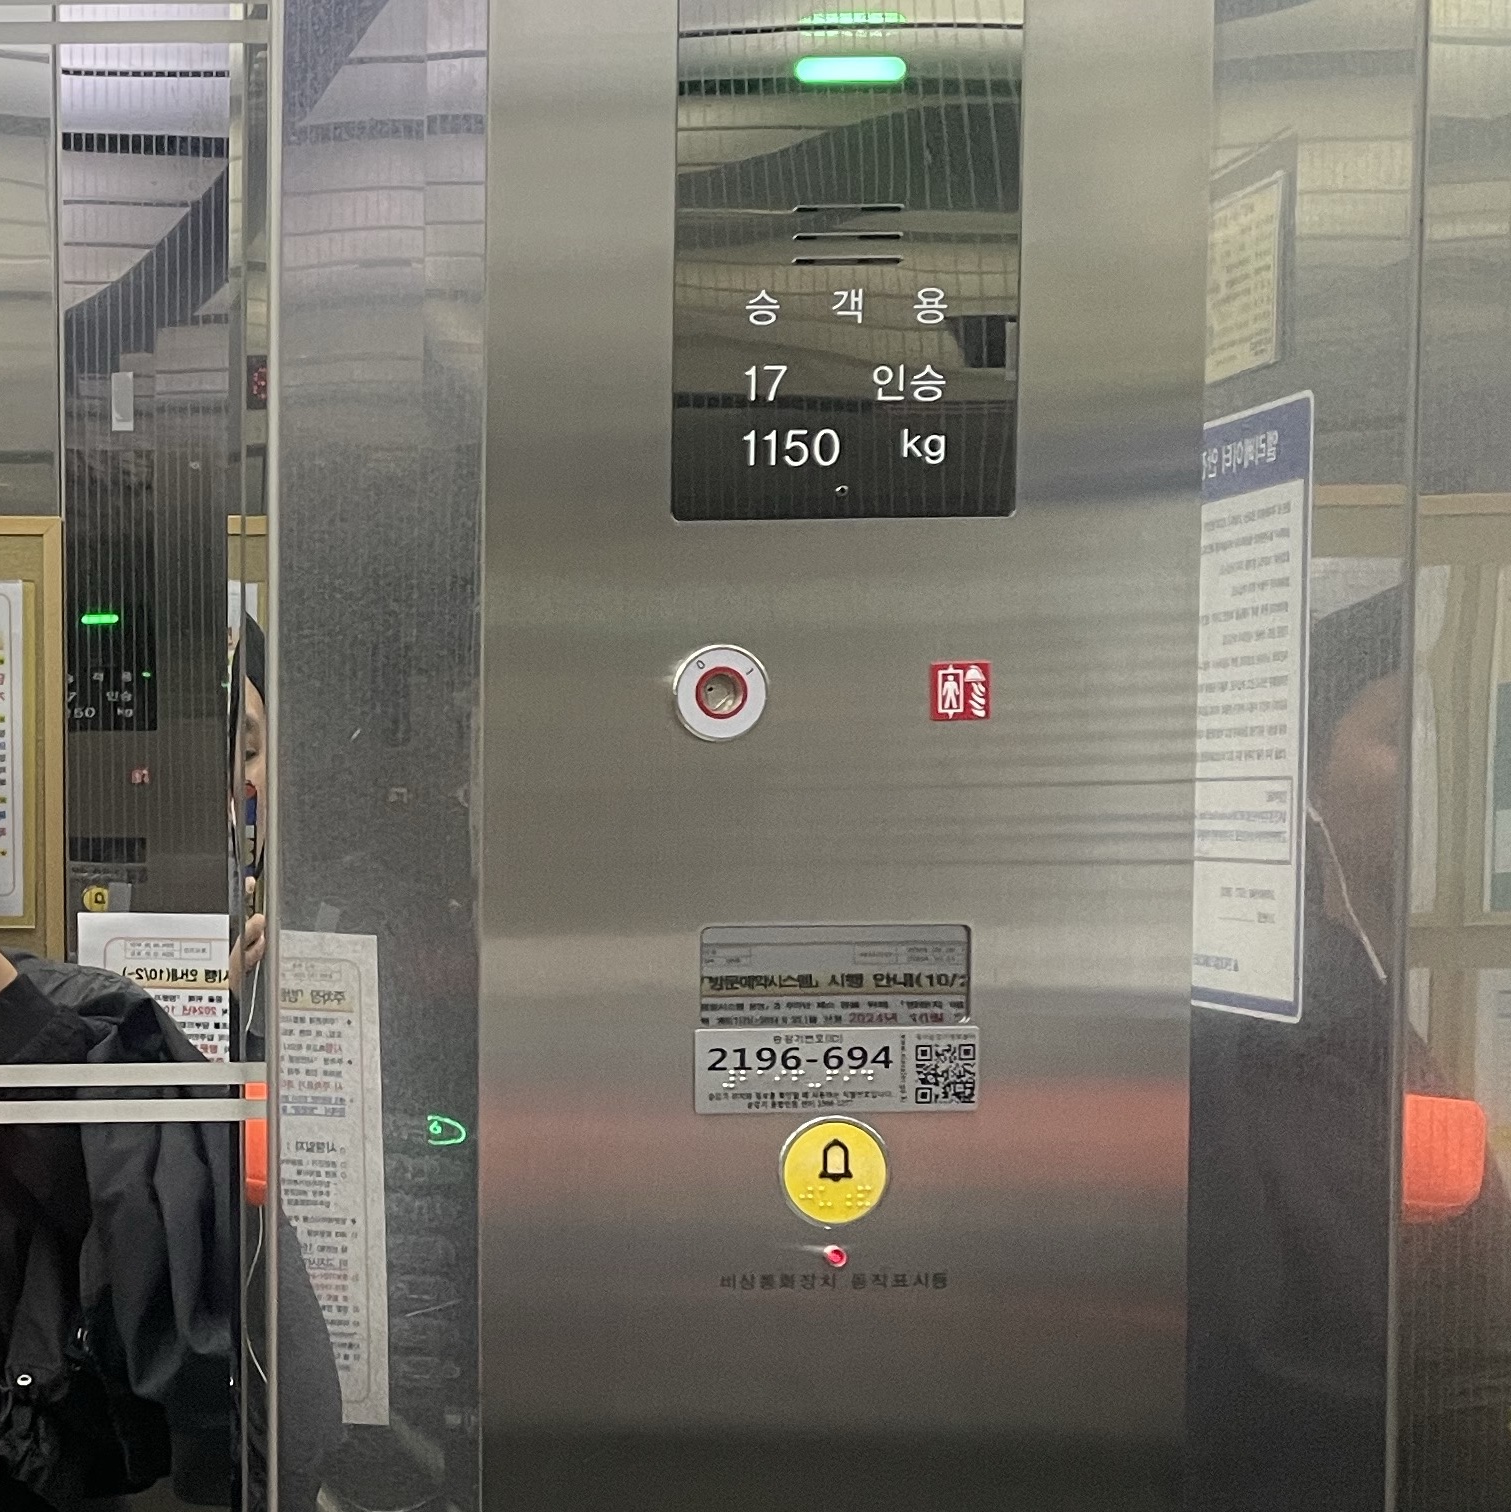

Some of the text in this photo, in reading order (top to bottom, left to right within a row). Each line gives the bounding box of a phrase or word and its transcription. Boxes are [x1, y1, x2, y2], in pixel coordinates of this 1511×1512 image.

[744, 364, 947, 401] 17 인승
[742, 428, 946, 466] 1150 kg
[708, 1046, 893, 1071] 2196-694
[720, 1272, 948, 1290] 비상통화장치 동작표시등
